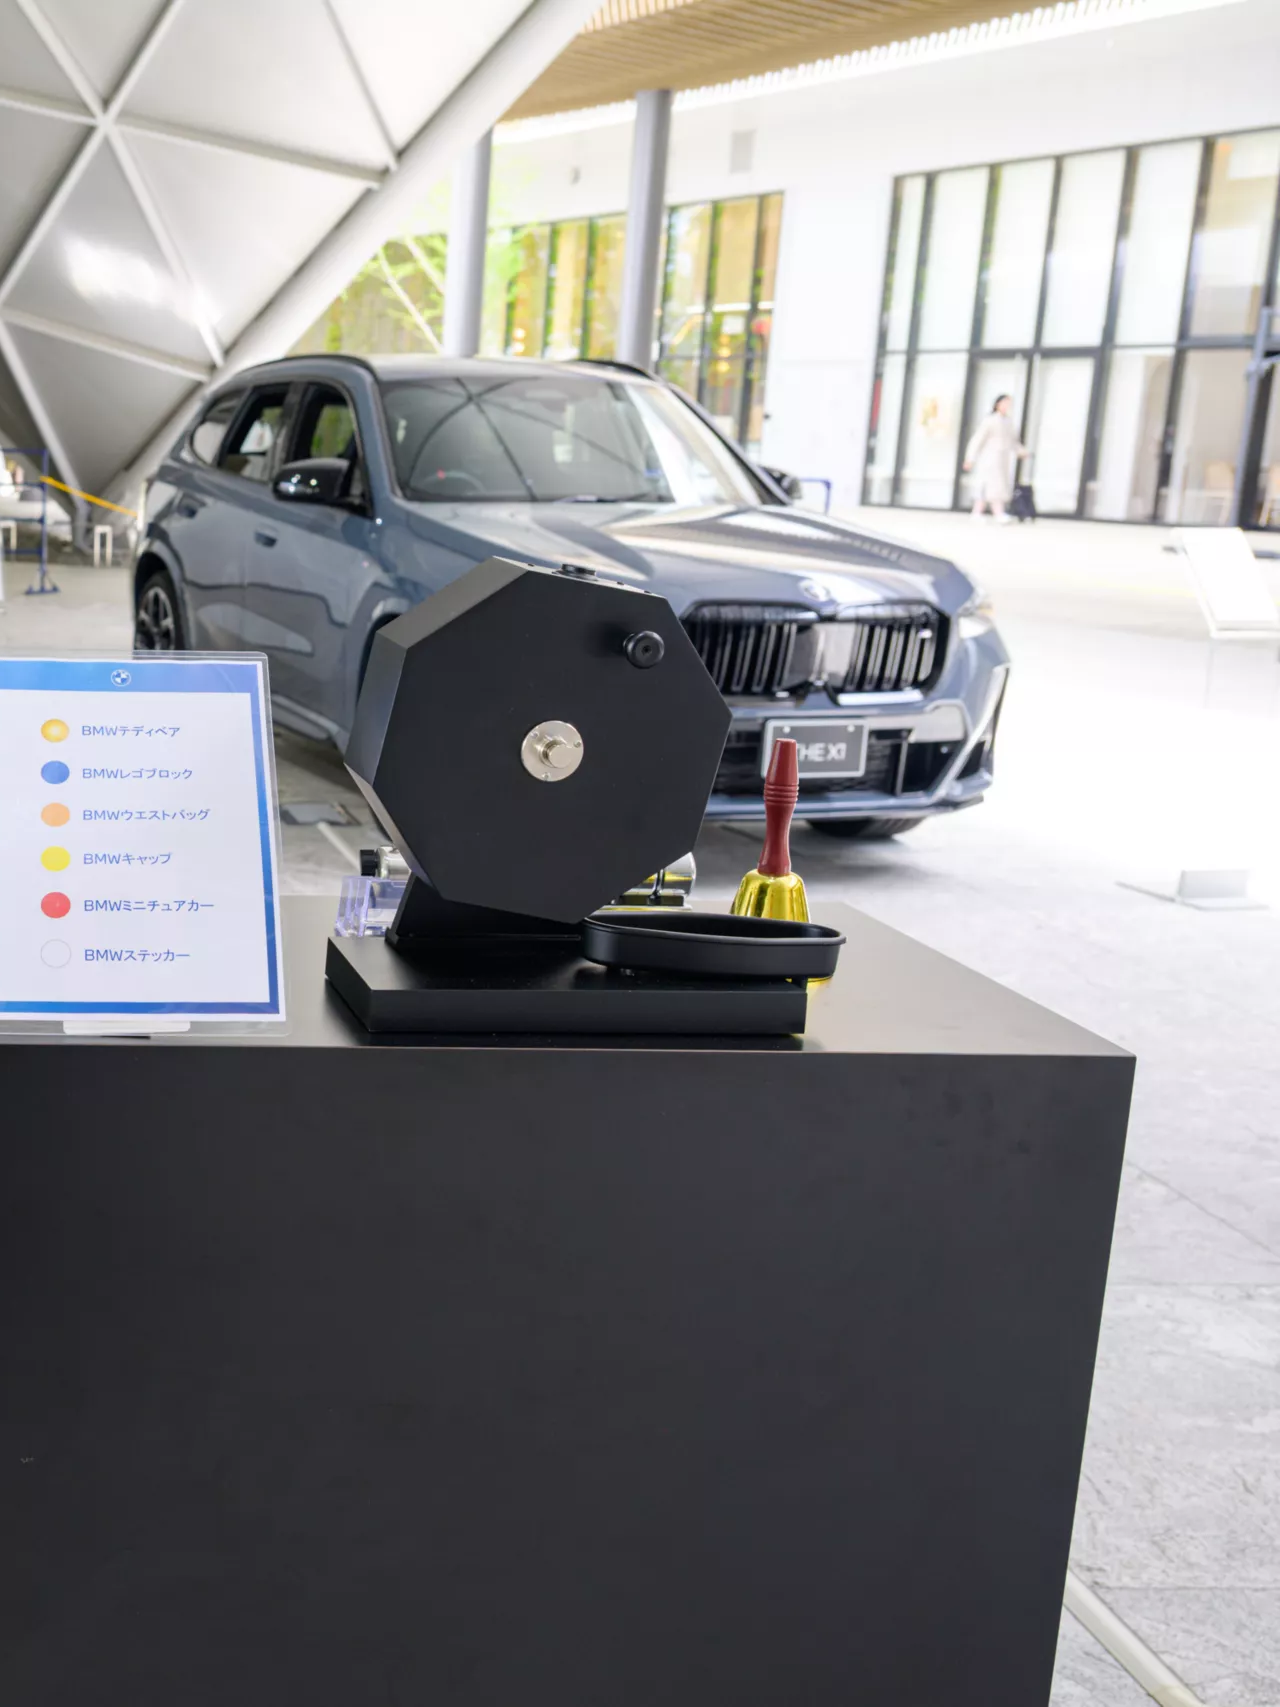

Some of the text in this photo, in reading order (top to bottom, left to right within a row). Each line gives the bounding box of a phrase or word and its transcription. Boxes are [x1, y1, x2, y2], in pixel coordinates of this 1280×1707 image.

[81, 725, 180, 737] BMWテディベア
[797, 743, 825, 761] HE
[82, 768, 193, 780] BMWレゴブロック
[83, 809, 211, 821] BMWウエストバッグ
[83, 853, 172, 865] BMWキャップ
[84, 899, 214, 912] BMWミニチュアカー
[84, 949, 190, 962] BMWステッカー
